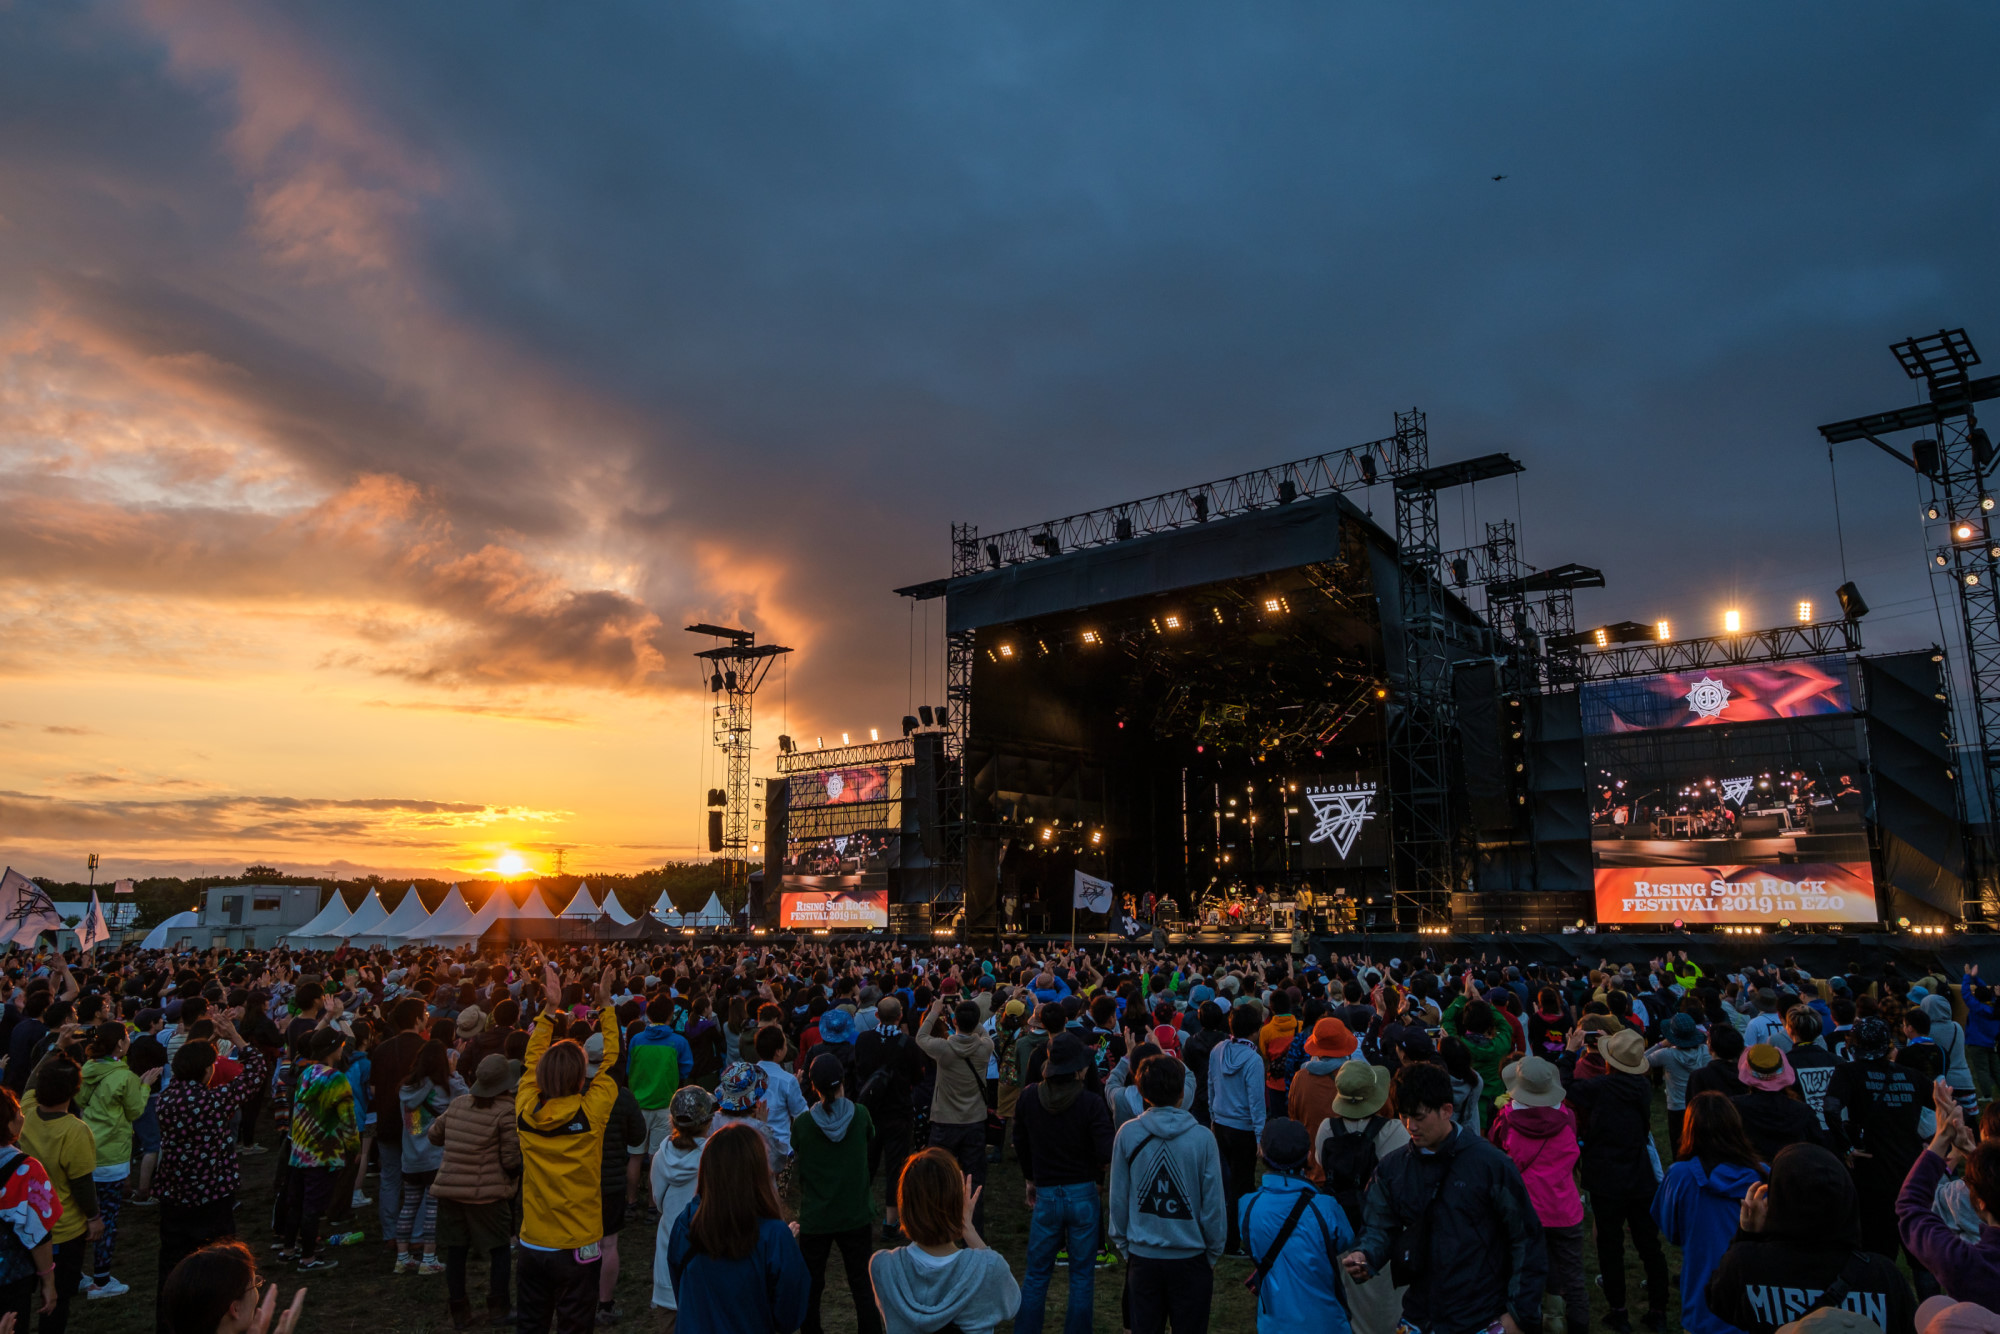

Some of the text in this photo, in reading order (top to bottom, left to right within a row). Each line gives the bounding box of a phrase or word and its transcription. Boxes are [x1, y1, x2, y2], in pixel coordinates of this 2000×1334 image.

[1634, 878, 1826, 898] RISING SUN ROCK
[796, 900, 870, 912] RISING SUN ROCK
[1622, 895, 1845, 913] FESTIVAL 2019 in EZO
[790, 912, 829, 921] FESTIVAL
[829, 912, 849, 921] 2019
[850, 912, 858, 920] in
